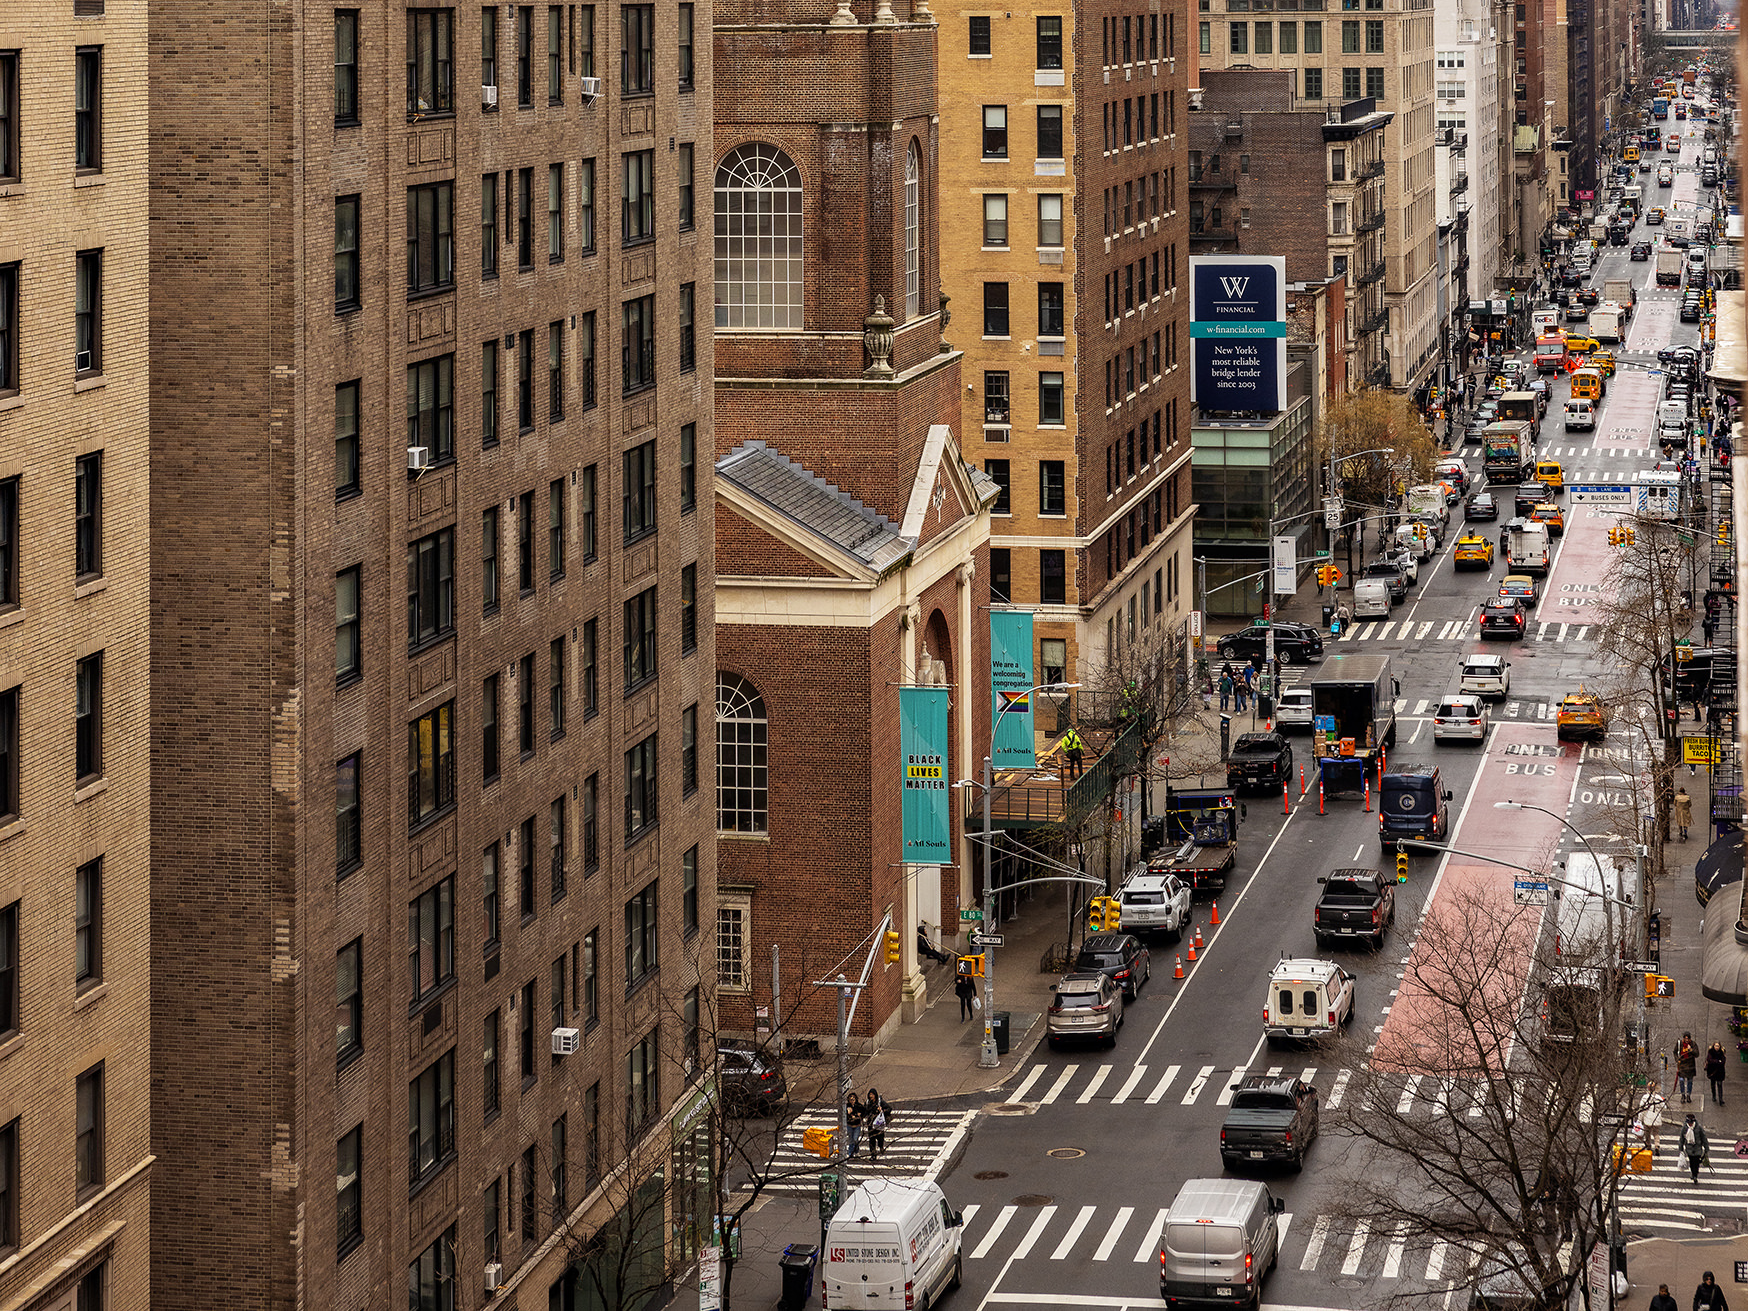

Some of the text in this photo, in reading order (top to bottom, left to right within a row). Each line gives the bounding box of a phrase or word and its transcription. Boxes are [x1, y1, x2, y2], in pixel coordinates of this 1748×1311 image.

[1220, 277, 1250, 298] W
[1215, 346, 1258, 354] New York's
[1233, 357, 1260, 365] reliable
[1212, 368, 1261, 379] bridge lender
[1217, 380, 1256, 390] since 2003
[1327, 513, 1339, 521] 25
[1559, 597, 1600, 606] BUS
[993, 680, 1032, 688] congregation
[1507, 744, 1565, 757] ONLY
[908, 755, 941, 764] BLACK
[911, 767, 939, 777] LIVES
[1505, 763, 1556, 776] BUS
[906, 780, 945, 789] MATTER
[1581, 791, 1638, 805] ONLY
[876, 1248, 890, 1257] DESIGN
